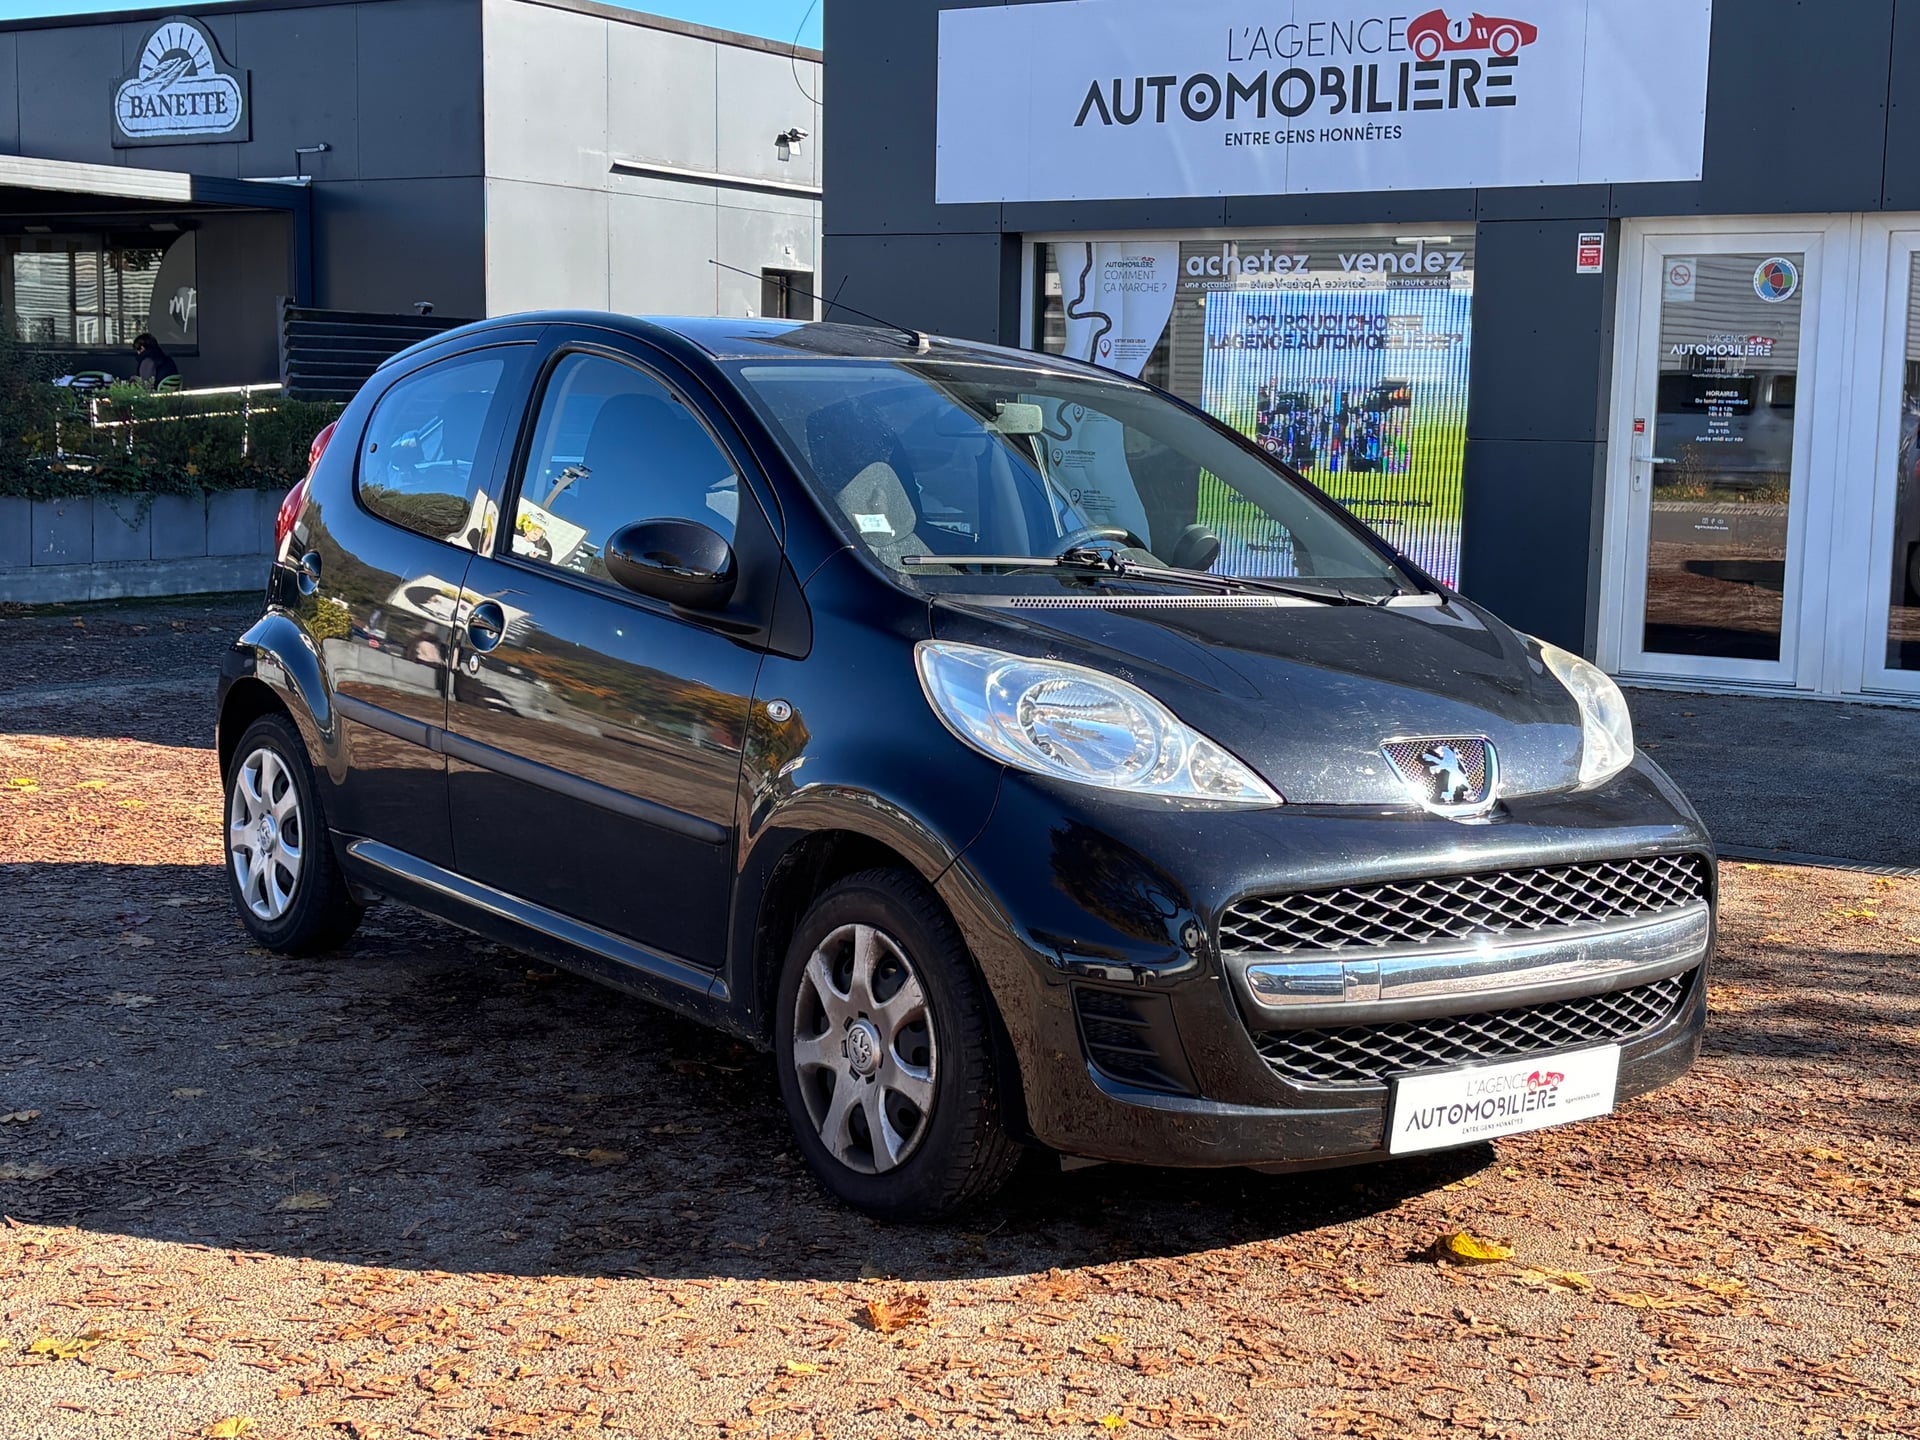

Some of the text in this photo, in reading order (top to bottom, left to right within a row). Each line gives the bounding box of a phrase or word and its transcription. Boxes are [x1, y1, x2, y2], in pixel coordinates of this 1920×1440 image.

[1228, 17, 1407, 62] L'AGENCE
[1454, 21, 1462, 38] 1
[129, 91, 228, 118] BANETTE
[1225, 122, 1402, 146] ENTRE GENS HONNÊTES
[1186, 240, 1465, 276] achetez vendez
[1104, 270, 1156, 280] COMMENT
[1104, 282, 1167, 294] ÇA MARCHE ?
[1246, 315, 1343, 331] POURQUOI
[1706, 335, 1748, 343] L'AGENCE
[1467, 1072, 1528, 1097] L'AGENCE
